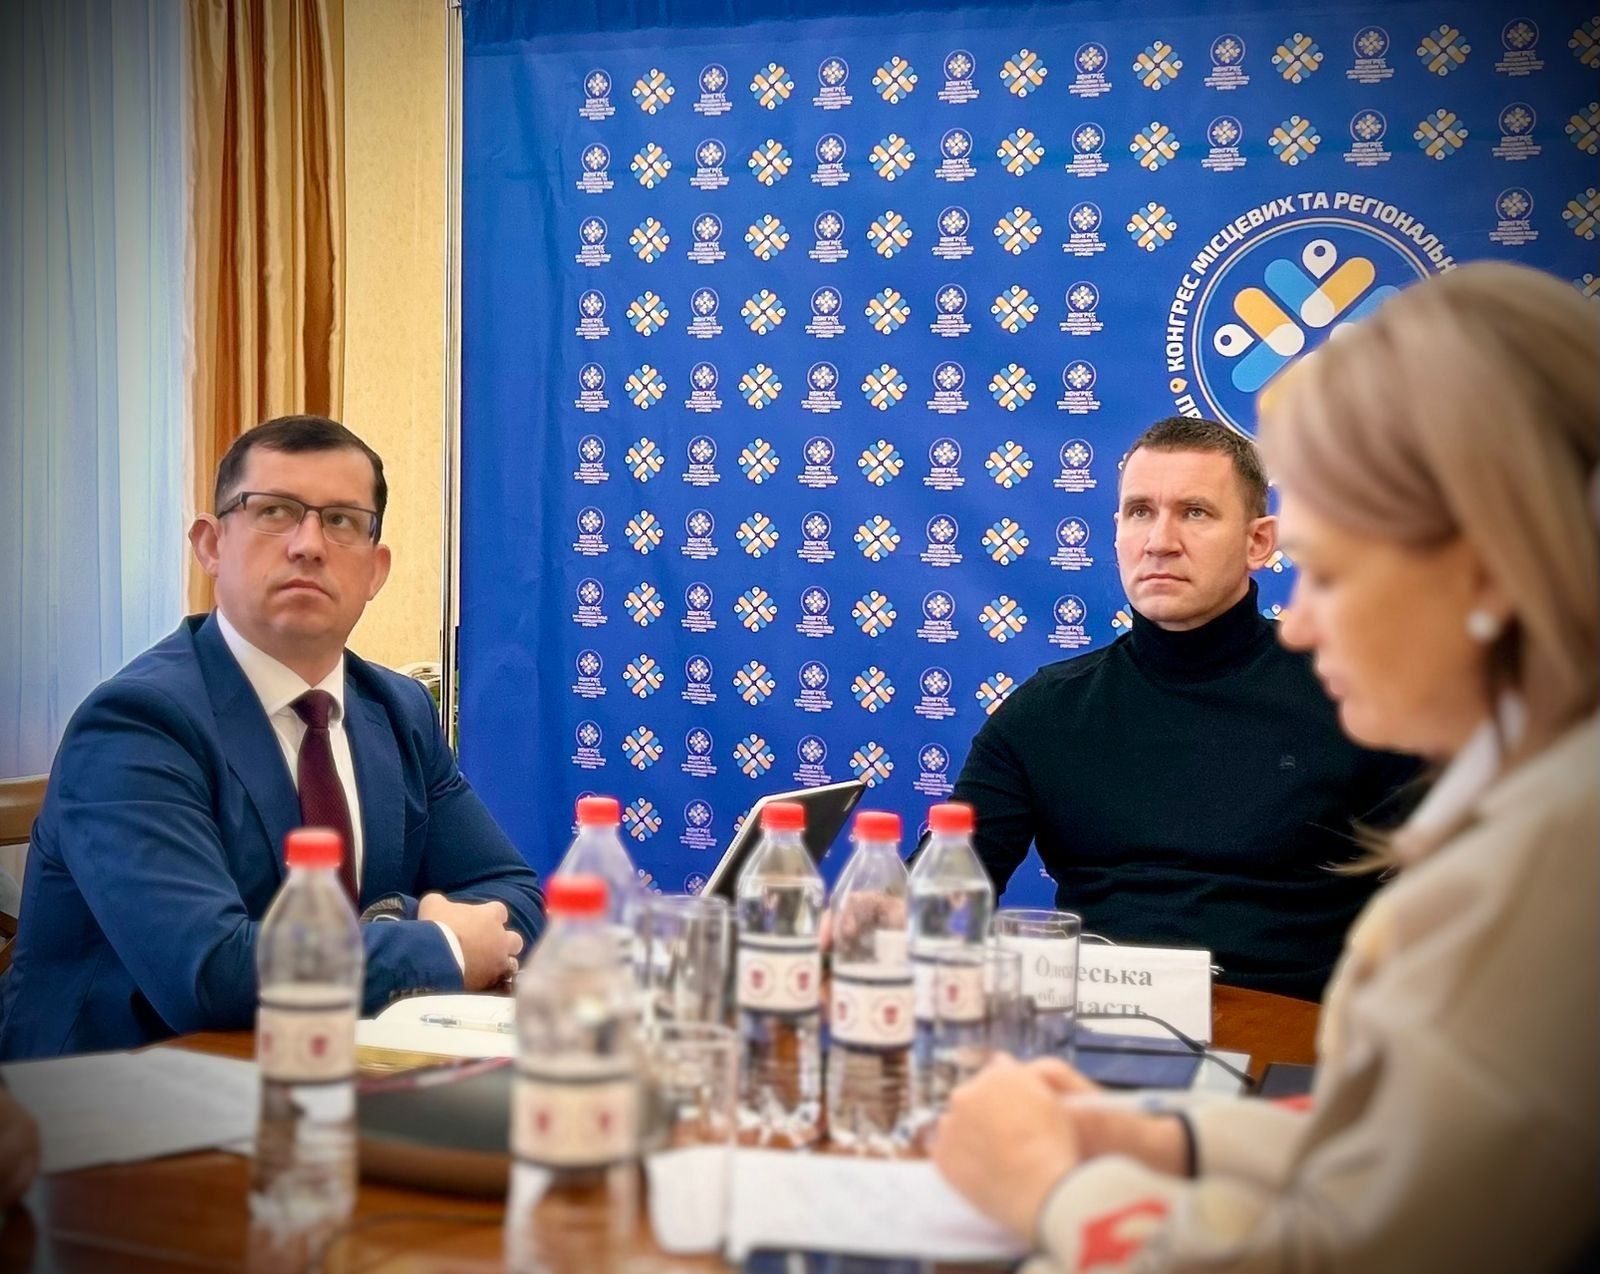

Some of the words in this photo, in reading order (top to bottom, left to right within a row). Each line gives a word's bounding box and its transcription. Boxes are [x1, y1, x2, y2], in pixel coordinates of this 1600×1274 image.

[1166, 273, 1201, 372] КОНГРЕС
[1190, 196, 1297, 275] МІСЦЕВИХ
[1297, 191, 1330, 210] ТА
[1333, 191, 1458, 275] РЕГІОНАЛЬН
